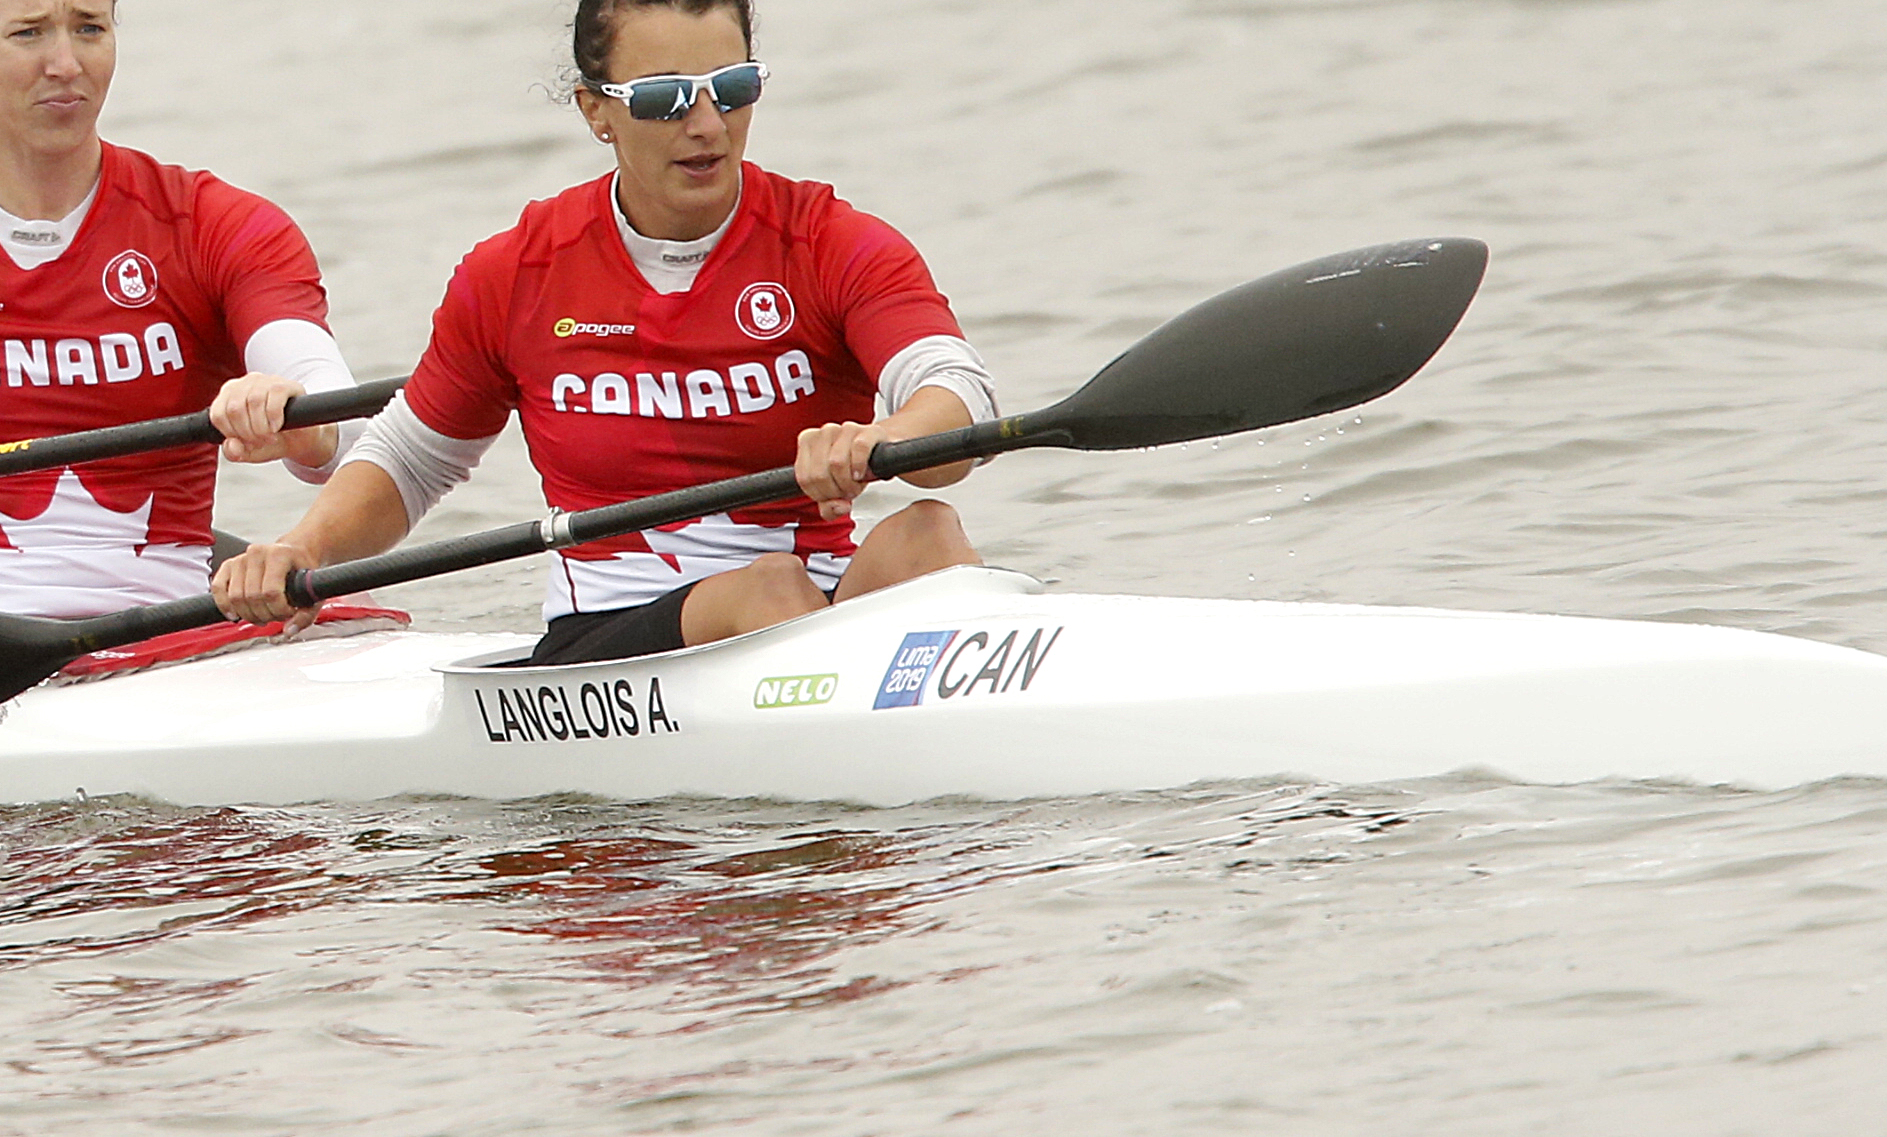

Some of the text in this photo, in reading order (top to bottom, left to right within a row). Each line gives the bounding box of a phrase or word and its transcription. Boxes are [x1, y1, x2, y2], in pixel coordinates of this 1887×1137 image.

[553, 317, 636, 337] apogee
[552, 349, 816, 419] CANADA
[885, 667, 927, 694] 2019
[938, 626, 1065, 699] CAN
[475, 676, 680, 742] LANGLOIS A.
[756, 677, 837, 705] NELO
